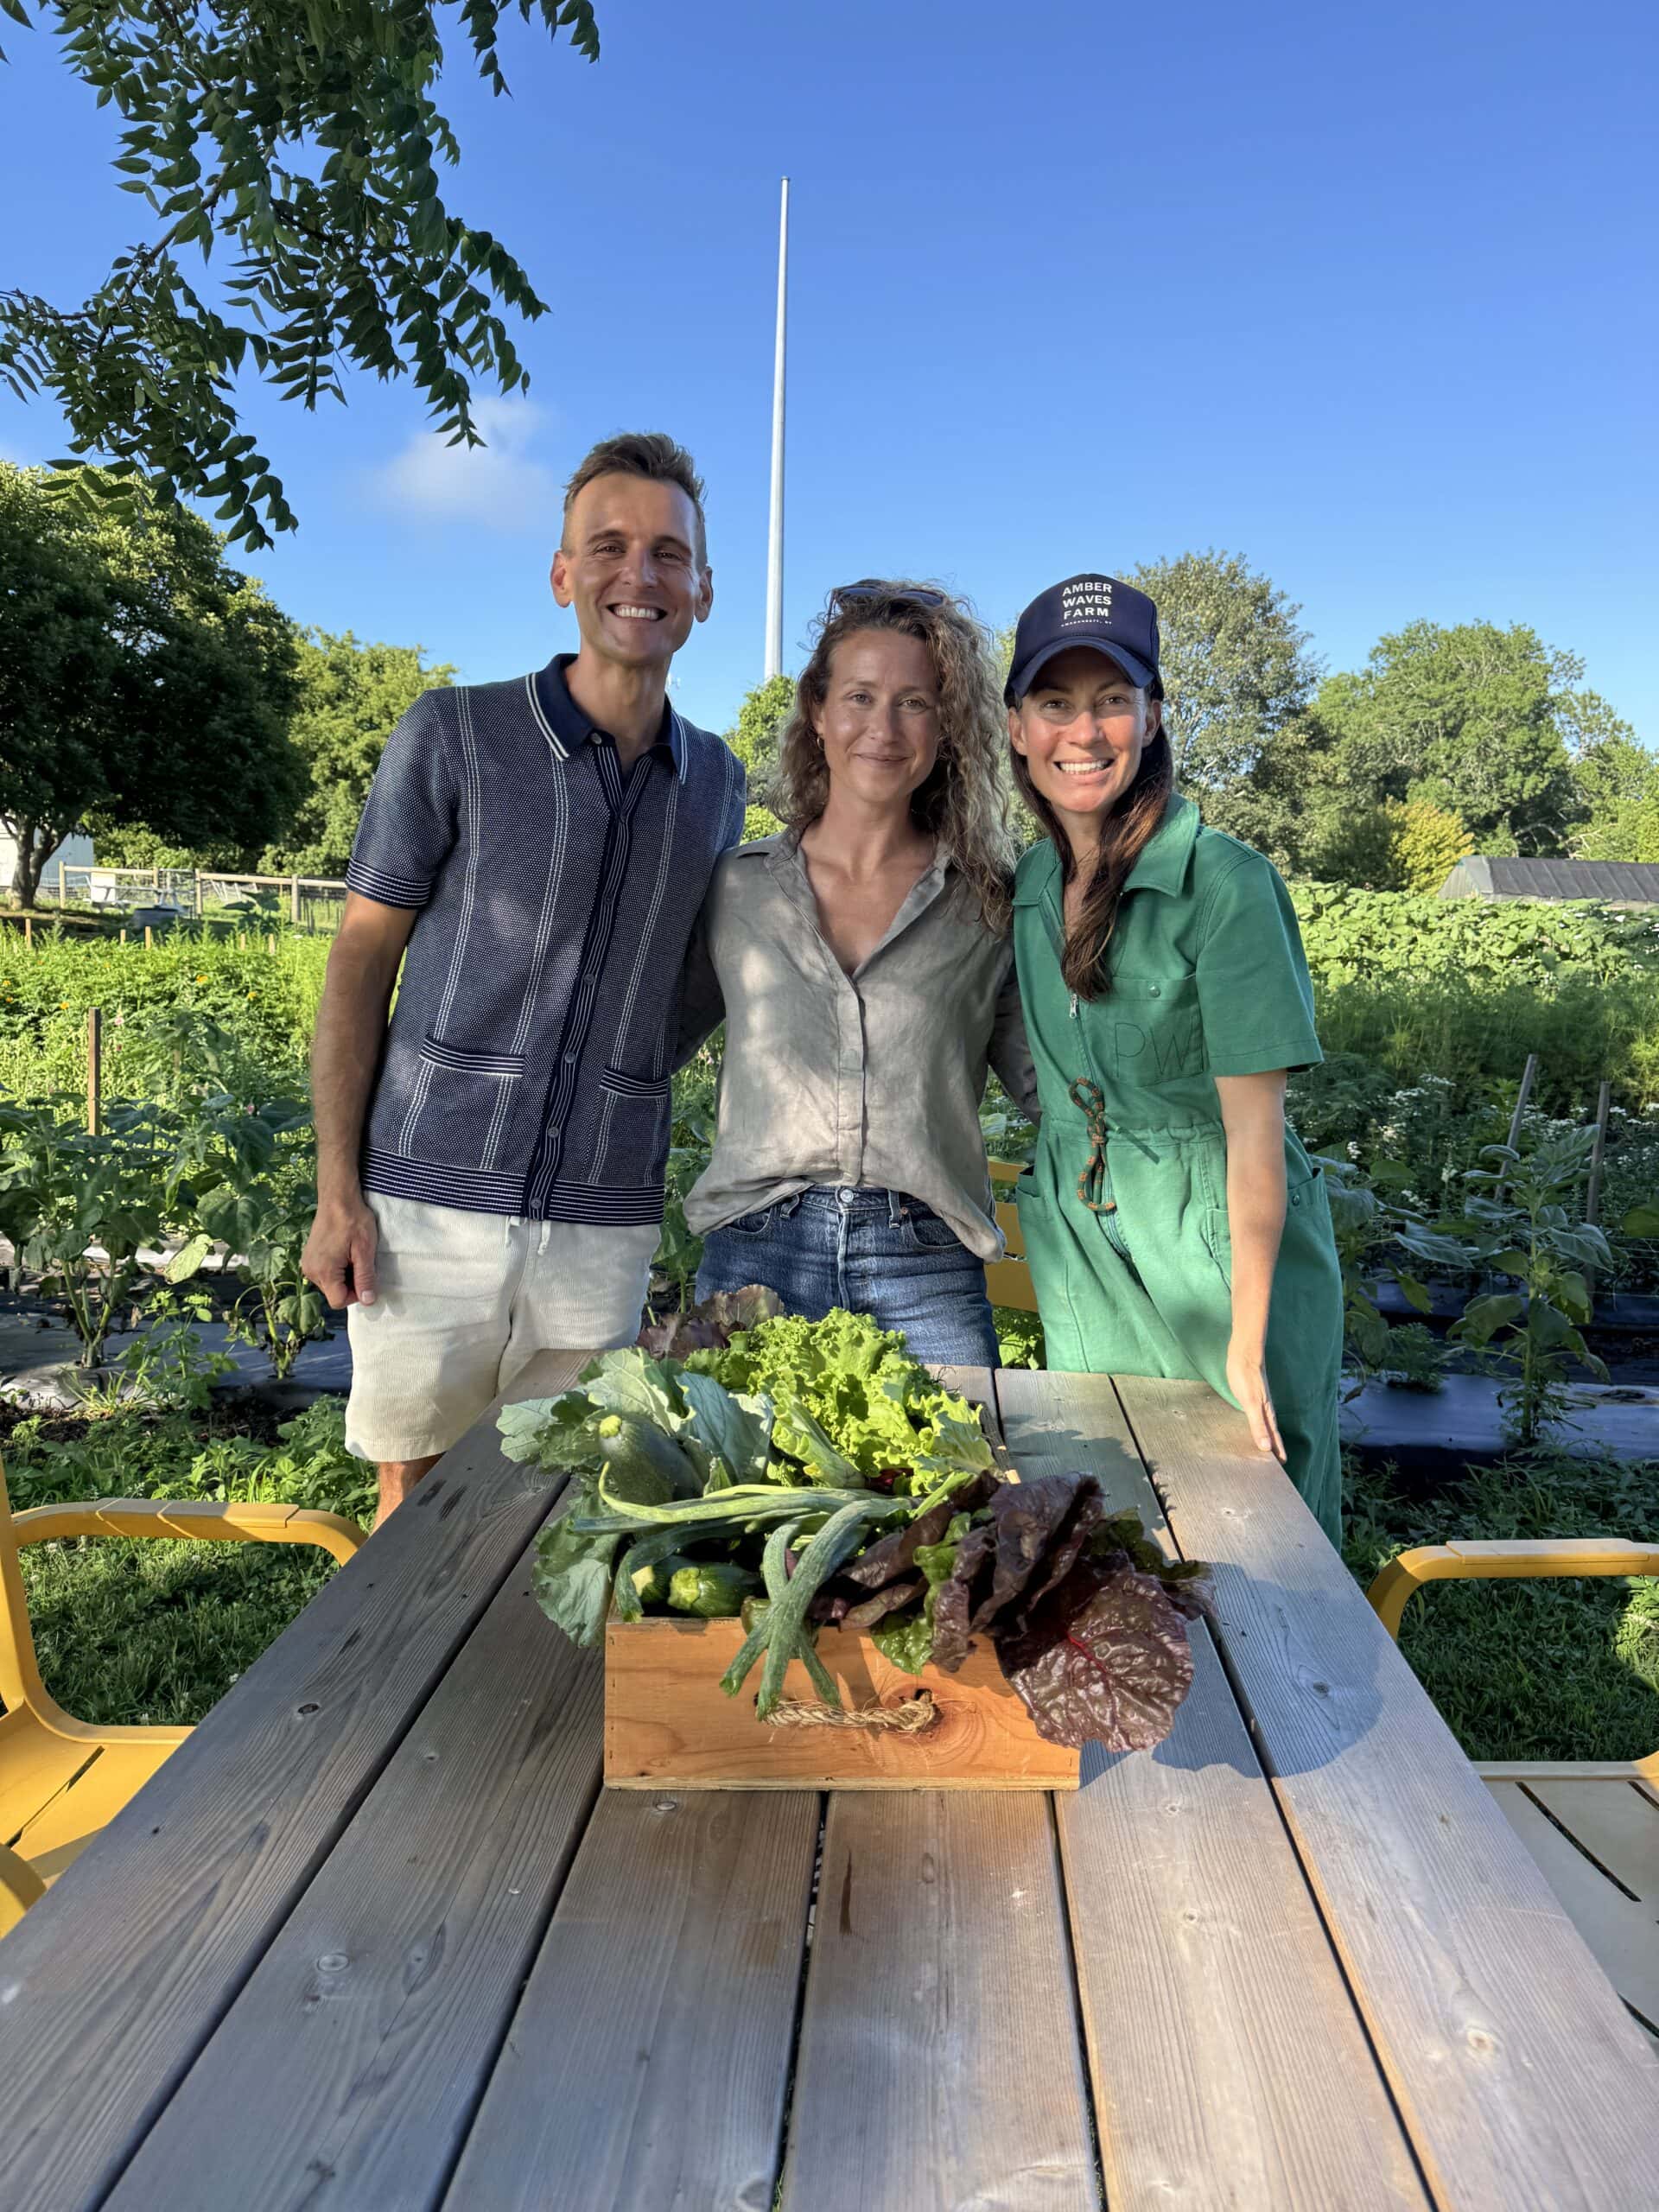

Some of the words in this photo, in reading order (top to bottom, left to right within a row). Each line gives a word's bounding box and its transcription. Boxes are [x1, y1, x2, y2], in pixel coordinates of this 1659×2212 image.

[1062, 582, 1112, 597] AMBER
[1062, 594, 1112, 608] WAVES
[1064, 607, 1109, 620] FARM
[1114, 1015, 1194, 1078] PW
